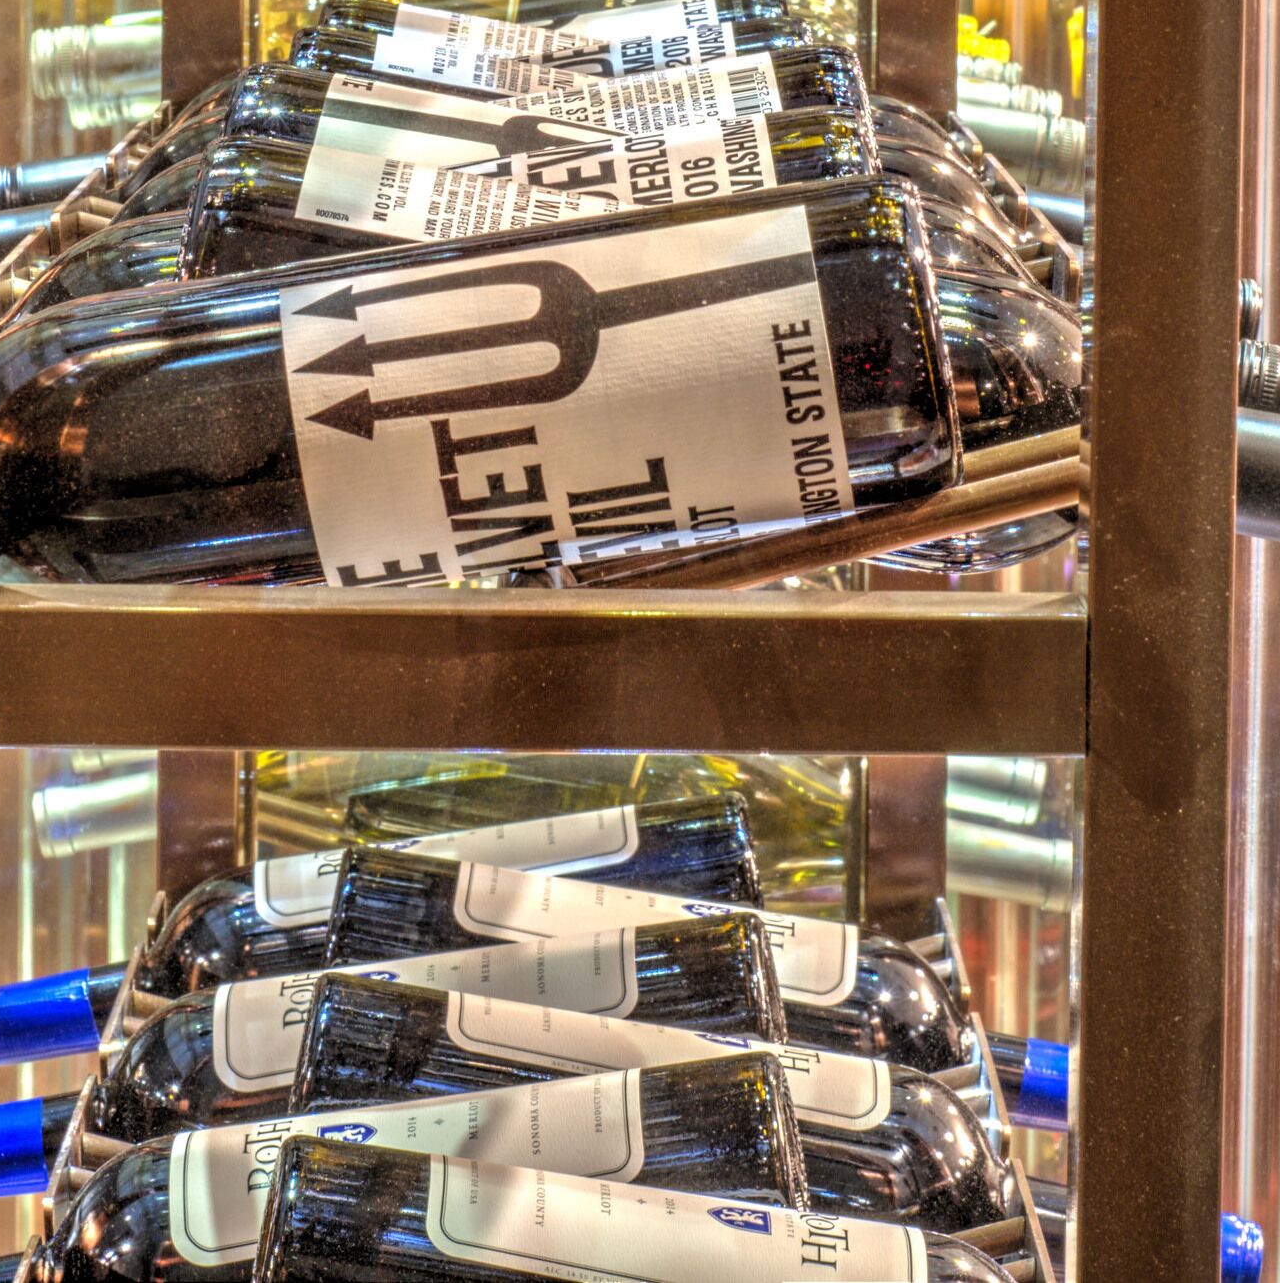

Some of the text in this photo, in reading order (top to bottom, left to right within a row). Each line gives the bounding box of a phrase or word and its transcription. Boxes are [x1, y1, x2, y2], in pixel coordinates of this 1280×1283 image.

[664, 106, 676, 126] DRIVE
[393, 196, 408, 211] VOL.
[428, 200, 441, 216] AND
[424, 218, 438, 237] MAY
[439, 218, 454, 239] YOUR
[772, 319, 826, 425] STATE
[481, 951, 492, 983] MERLOT
[536, 956, 546, 995] SONOMA
[408, 1116, 417, 1139] 2014
[469, 1100, 481, 1141] MERLOT
[594, 1097, 604, 1133] PRODUCT
[531, 1108, 542, 1156] SONOMA
[536, 1181, 548, 1227] COUNTY
